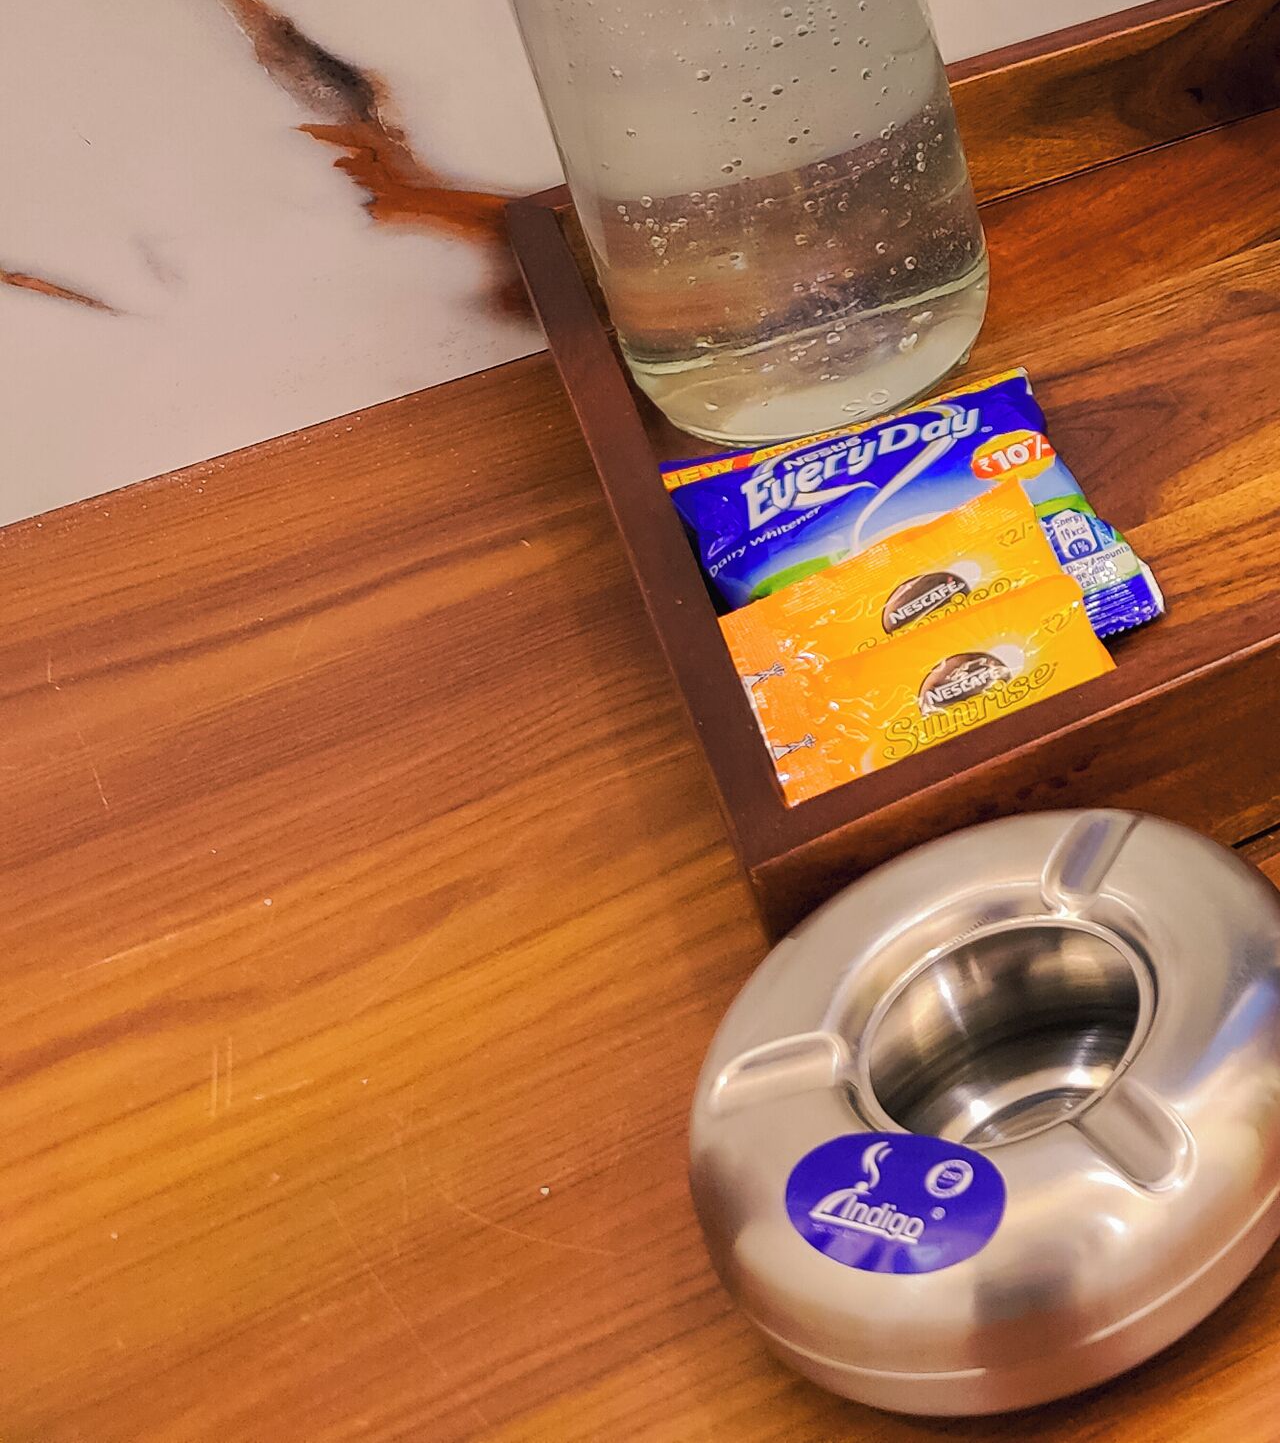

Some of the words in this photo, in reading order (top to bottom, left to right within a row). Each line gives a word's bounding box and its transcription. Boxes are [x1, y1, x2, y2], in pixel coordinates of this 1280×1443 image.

[1054, 515, 1084, 529] Energy
[1070, 540, 1090, 555] 1%
[708, 545, 748, 580] Dairy
[882, 662, 1052, 761] Sunrise
